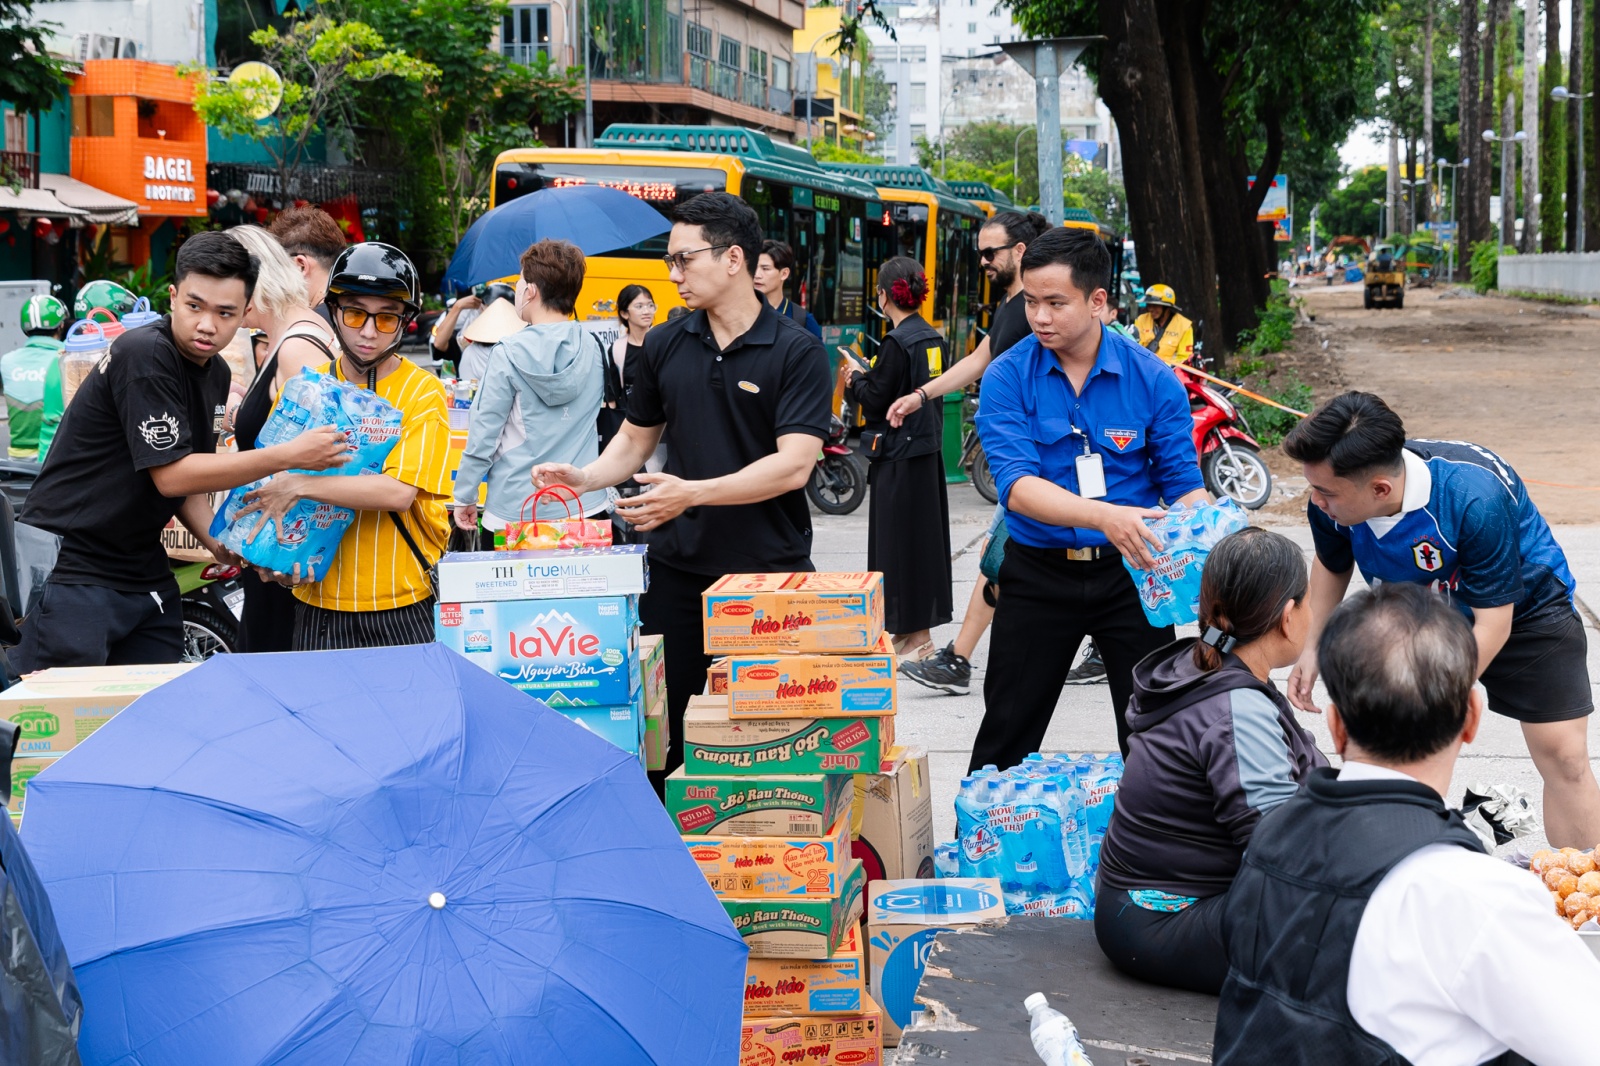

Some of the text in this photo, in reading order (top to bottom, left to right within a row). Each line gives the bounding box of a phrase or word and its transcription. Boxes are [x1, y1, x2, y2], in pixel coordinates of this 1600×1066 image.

[144, 155, 194, 182] BAGEL
[145, 185, 195, 202] BROTHERS
[75, 302, 87, 311] ab
[316, 504, 335, 512] OW!
[161, 530, 207, 550] HOLIDA
[492, 566, 514, 578] TH
[475, 580, 518, 588] SWEETENED
[751, 615, 780, 635] Hảo
[782, 611, 811, 630] Hảo
[509, 626, 600, 658] laVie
[500, 661, 597, 682] Nguyên Bản
[776, 675, 837, 699] Hảo Hảo
[21, 741, 51, 751] CANXI
[693, 727, 830, 767] Bò Rau Thơm
[821, 755, 860, 770] Unif
[686, 786, 718, 799] Unif
[1090, 783, 1118, 796] KHIẾT
[720, 787, 815, 811] Bò Rau Thơm
[988, 805, 1016, 817] WOW!
[989, 809, 1040, 827] TINH KHIẾT
[1004, 822, 1025, 832] THẬT
[734, 853, 775, 868] Hảo Hảo
[806, 869, 830, 887] 25
[886, 893, 920, 910] ICY
[1023, 899, 1055, 911] WOW!
[1049, 901, 1077, 916] KHIẾT
[733, 909, 821, 930] Bò Rau Thơm
[914, 941, 934, 970] IC
[744, 976, 805, 1000] Hảo Hảo
[741, 1033, 752, 1052] 2
[782, 1044, 831, 1065] Hảo Hảo
